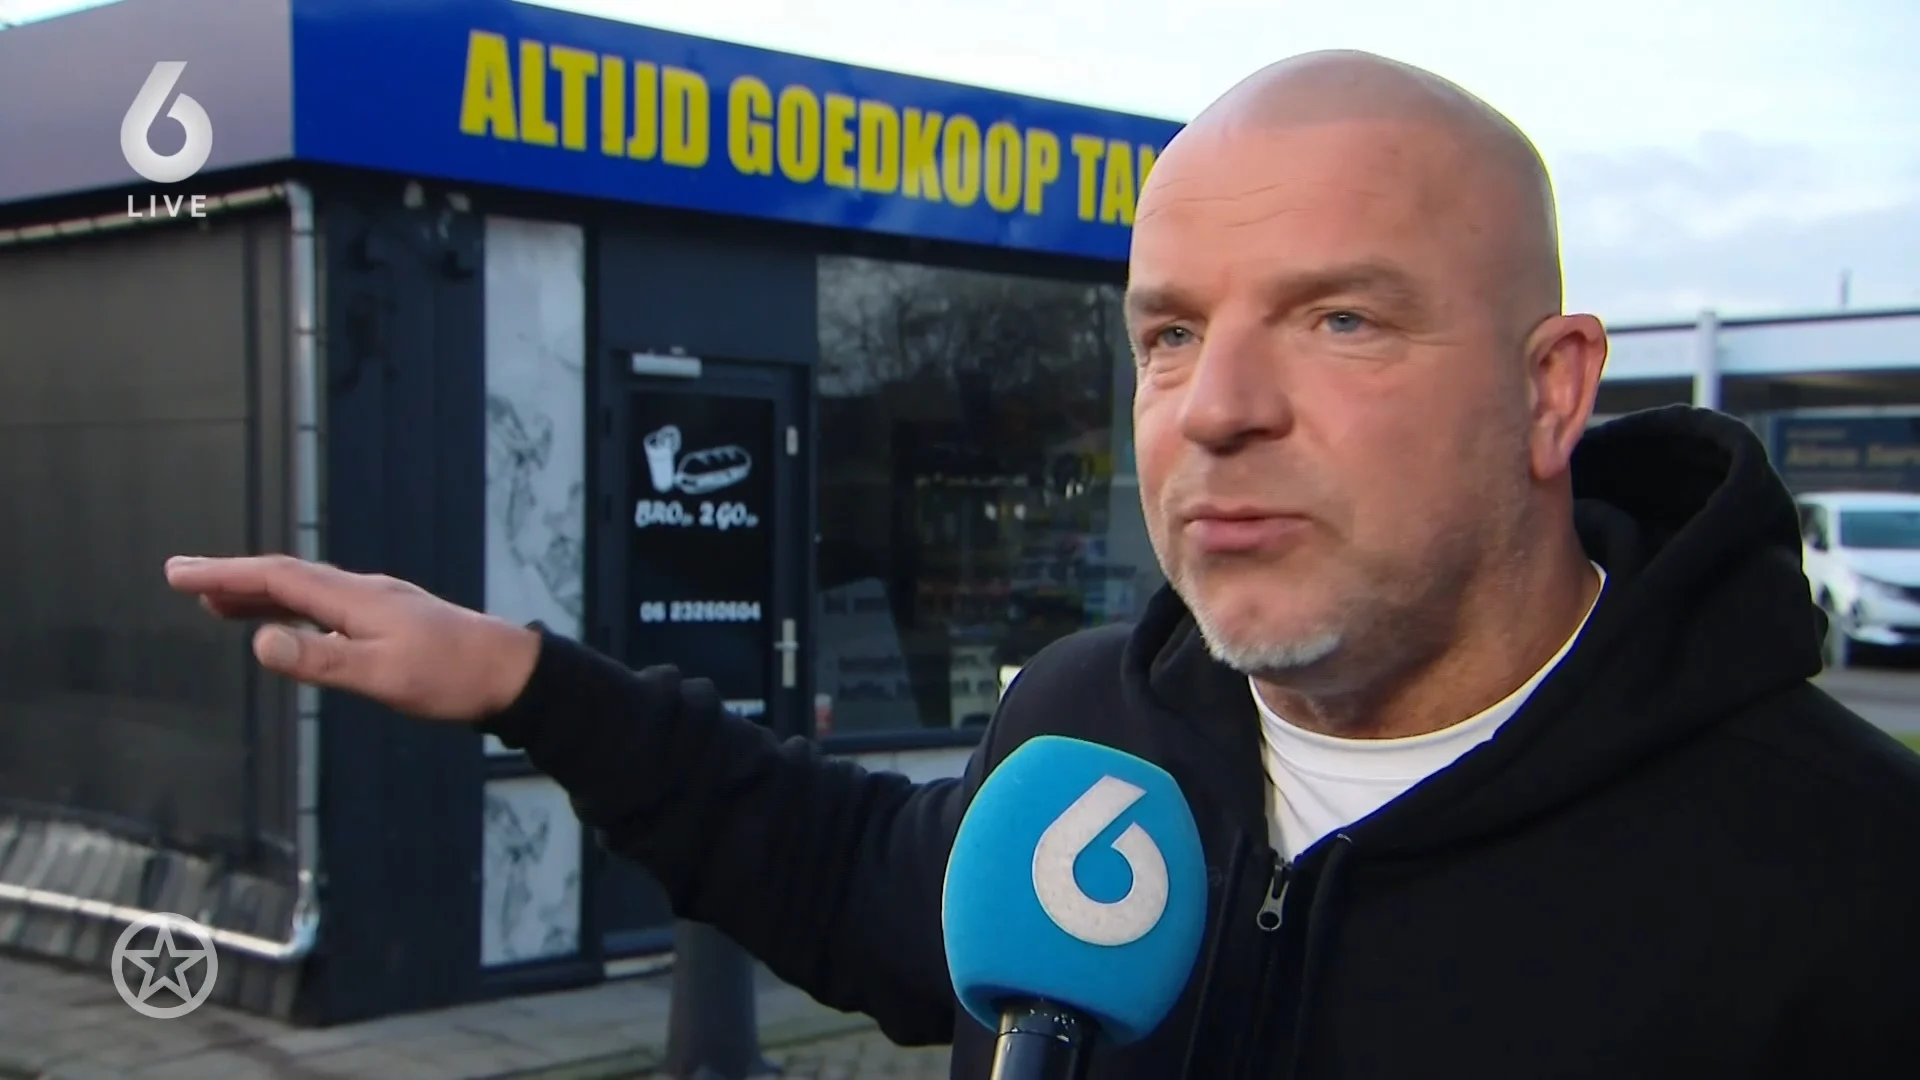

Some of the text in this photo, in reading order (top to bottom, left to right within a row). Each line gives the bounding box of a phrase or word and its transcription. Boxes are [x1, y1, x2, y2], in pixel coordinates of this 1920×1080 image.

[459, 31, 710, 168] ALTIJD
[727, 76, 1060, 216] GOEDKOOP
[1032, 774, 1169, 946] 6
